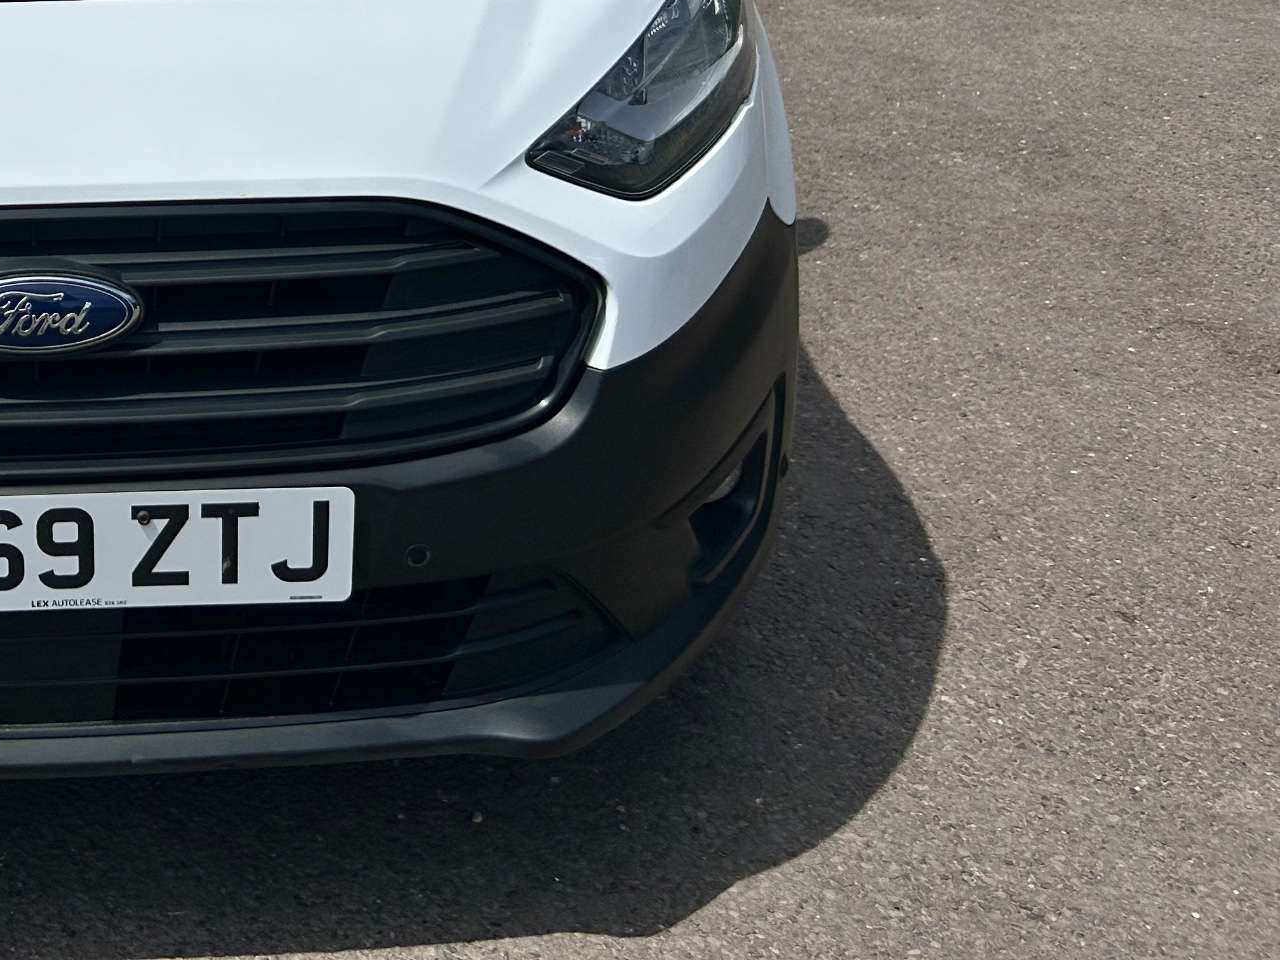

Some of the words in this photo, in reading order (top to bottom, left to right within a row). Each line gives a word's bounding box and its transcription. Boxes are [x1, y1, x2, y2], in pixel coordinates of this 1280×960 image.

[131, 500, 330, 588] ZTJ
[31, 600, 49, 608] LEX
[51, 599, 103, 607] AUTOLEASE
